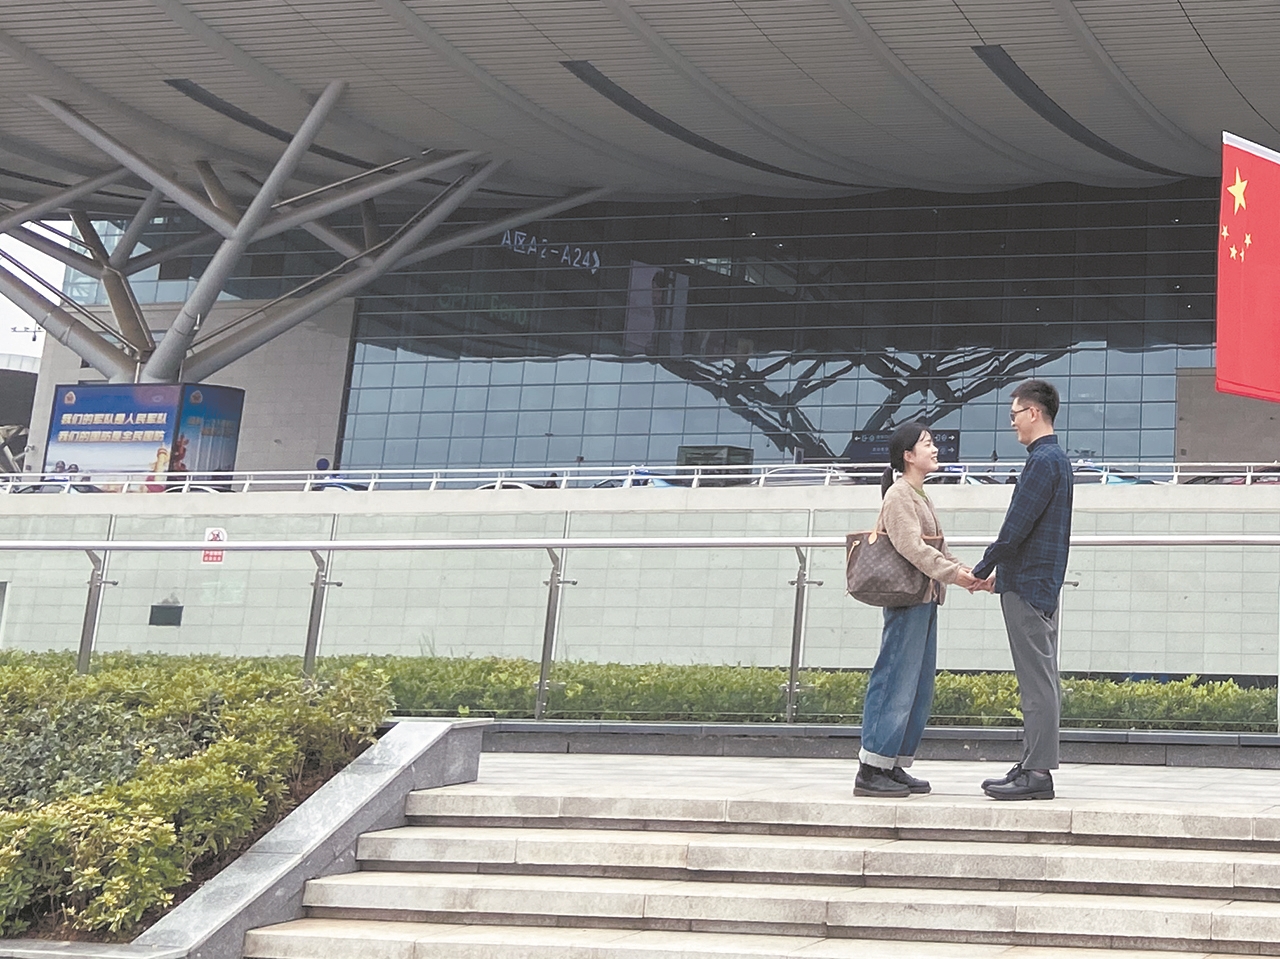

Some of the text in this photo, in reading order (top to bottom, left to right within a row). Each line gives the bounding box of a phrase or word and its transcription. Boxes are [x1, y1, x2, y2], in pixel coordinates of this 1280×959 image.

[61, 413, 168, 425] 我们的军队是人民军队
[58, 431, 166, 442] 我们的国防是全民国防
